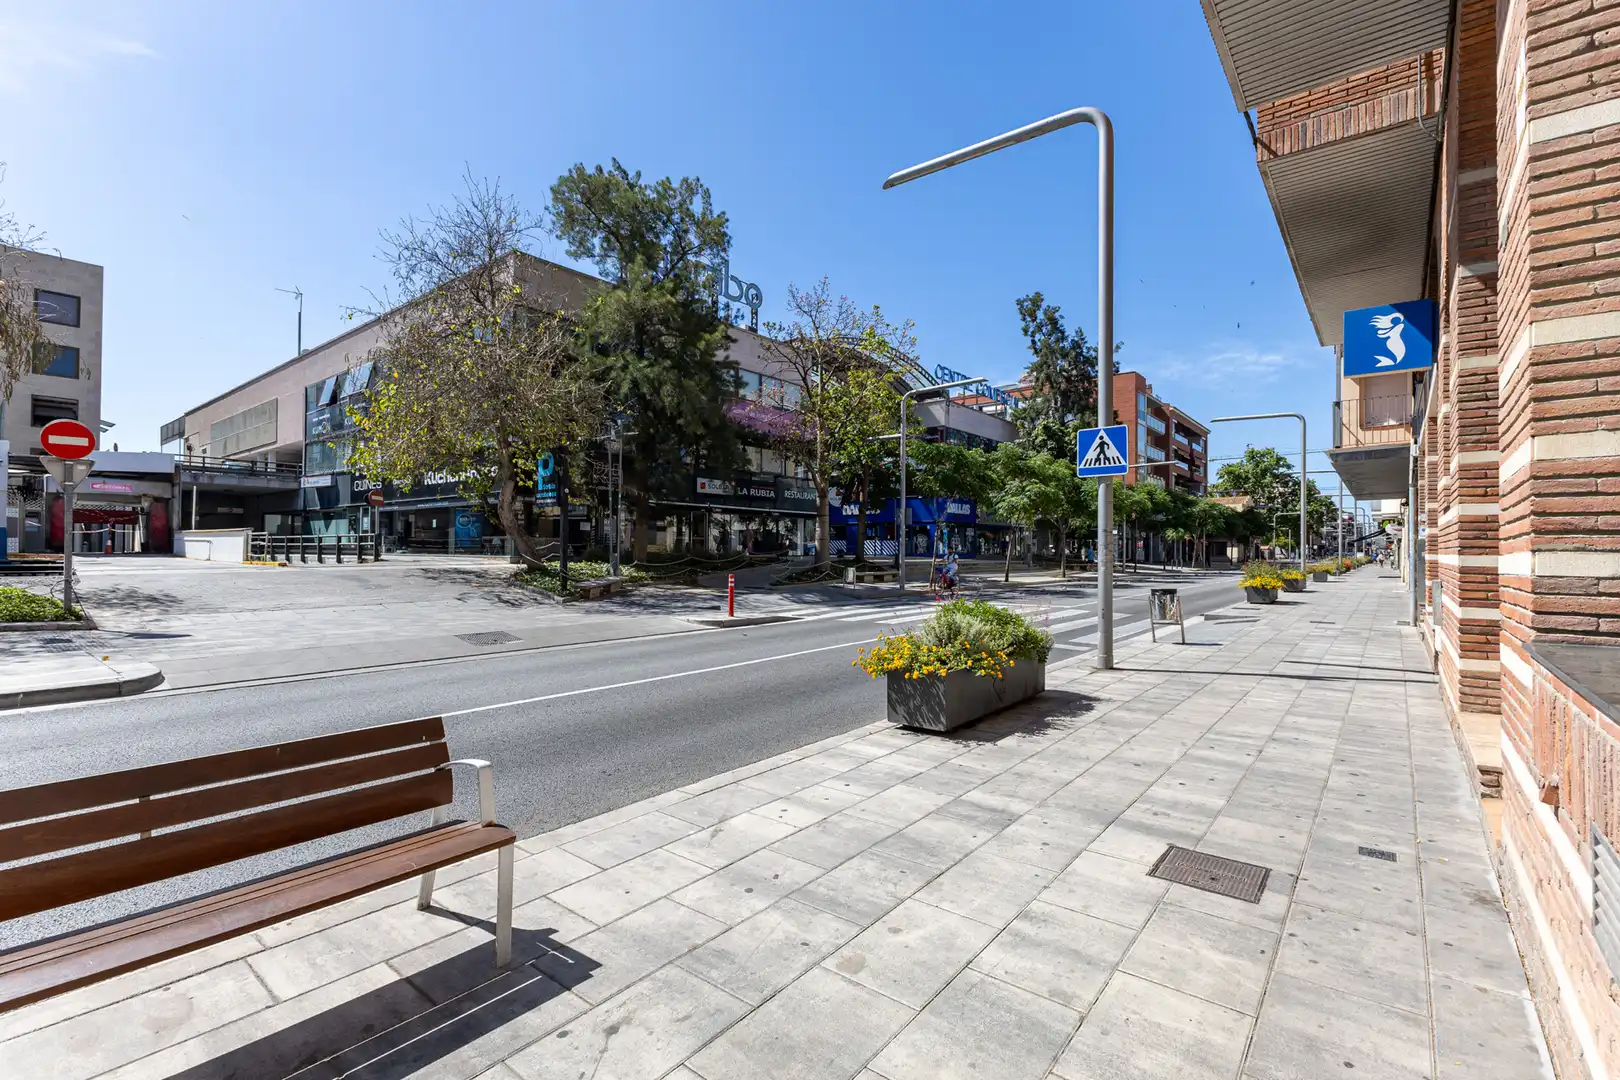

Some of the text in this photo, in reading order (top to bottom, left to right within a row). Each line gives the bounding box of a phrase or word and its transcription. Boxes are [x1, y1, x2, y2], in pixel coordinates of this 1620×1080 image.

[736, 486, 748, 496] LA
[750, 488, 776, 498] RUBIA
[946, 502, 971, 515] DALLAS
